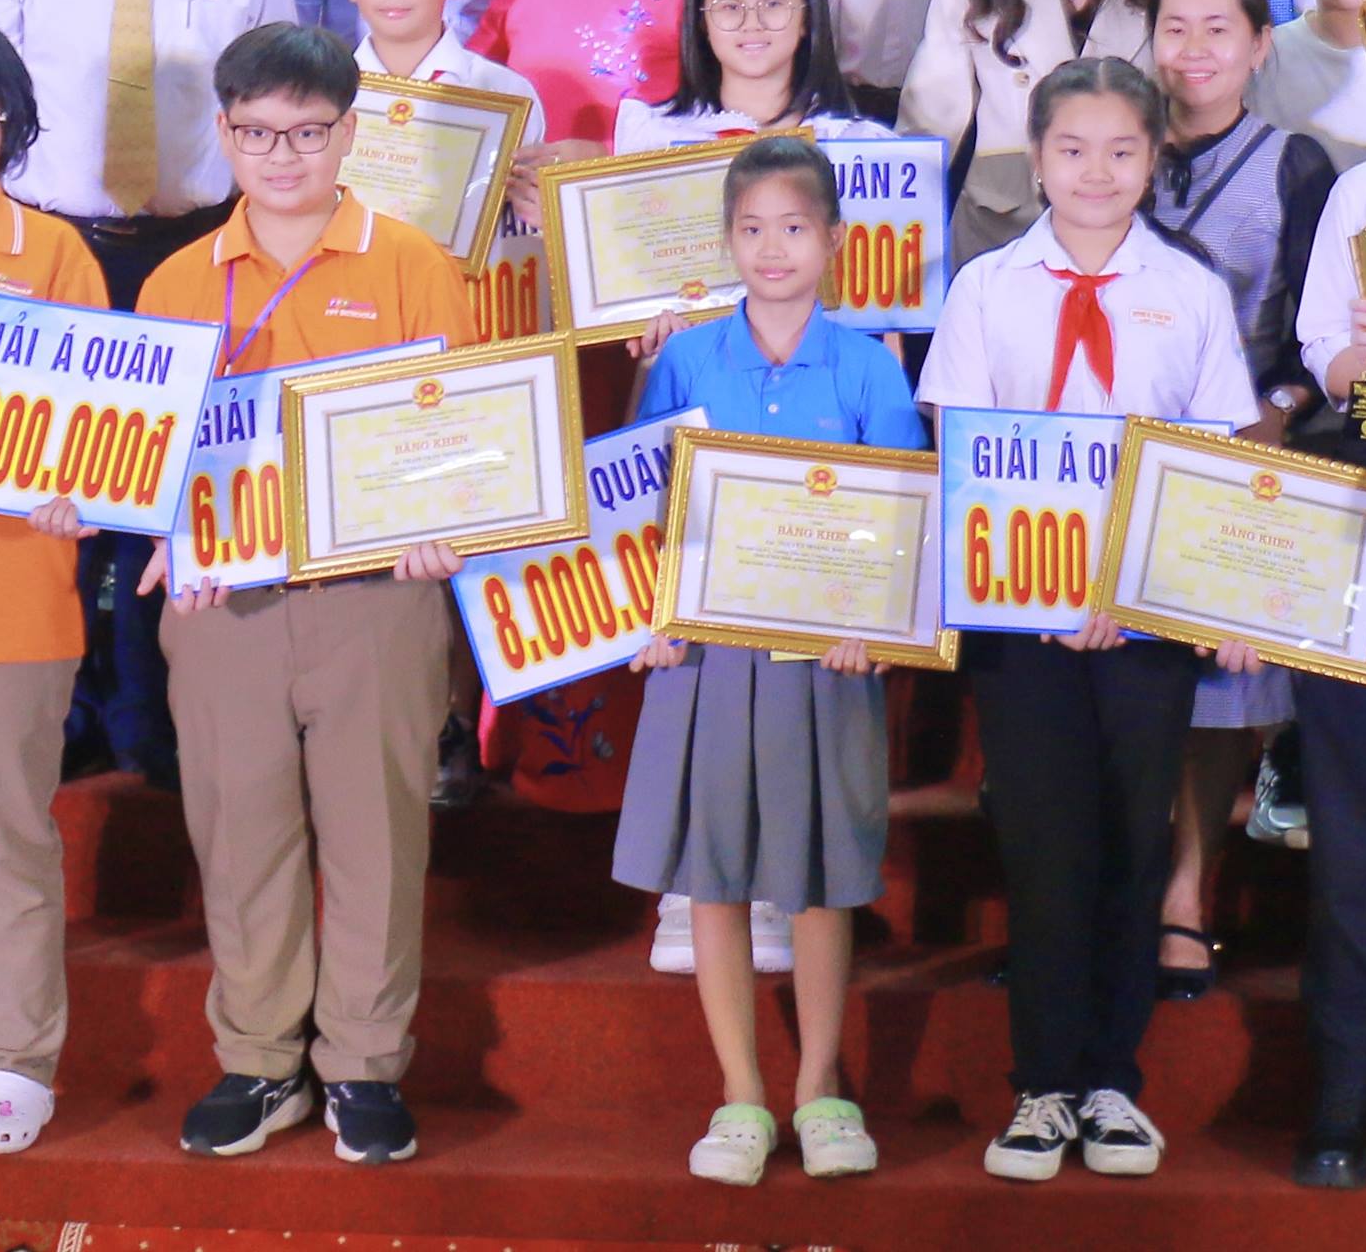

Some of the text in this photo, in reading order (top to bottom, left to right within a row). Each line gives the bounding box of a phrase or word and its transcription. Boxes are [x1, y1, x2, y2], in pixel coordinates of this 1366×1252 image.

[832, 155, 918, 200] UÂN 2
[836, 221, 923, 311] 00đ
[474, 256, 539, 345] 00đ
[51, 322, 73, 374] Á
[82, 332, 174, 385] QUÂN
[432, 434, 468, 450] KHEN
[972, 424, 1037, 483] GIẢI
[1057, 431, 1078, 483] Á
[589, 443, 672, 511] QUÂN
[191, 462, 283, 569] 6.00
[1258, 535, 1295, 550] KHEN
[964, 505, 1089, 609] 6.000
